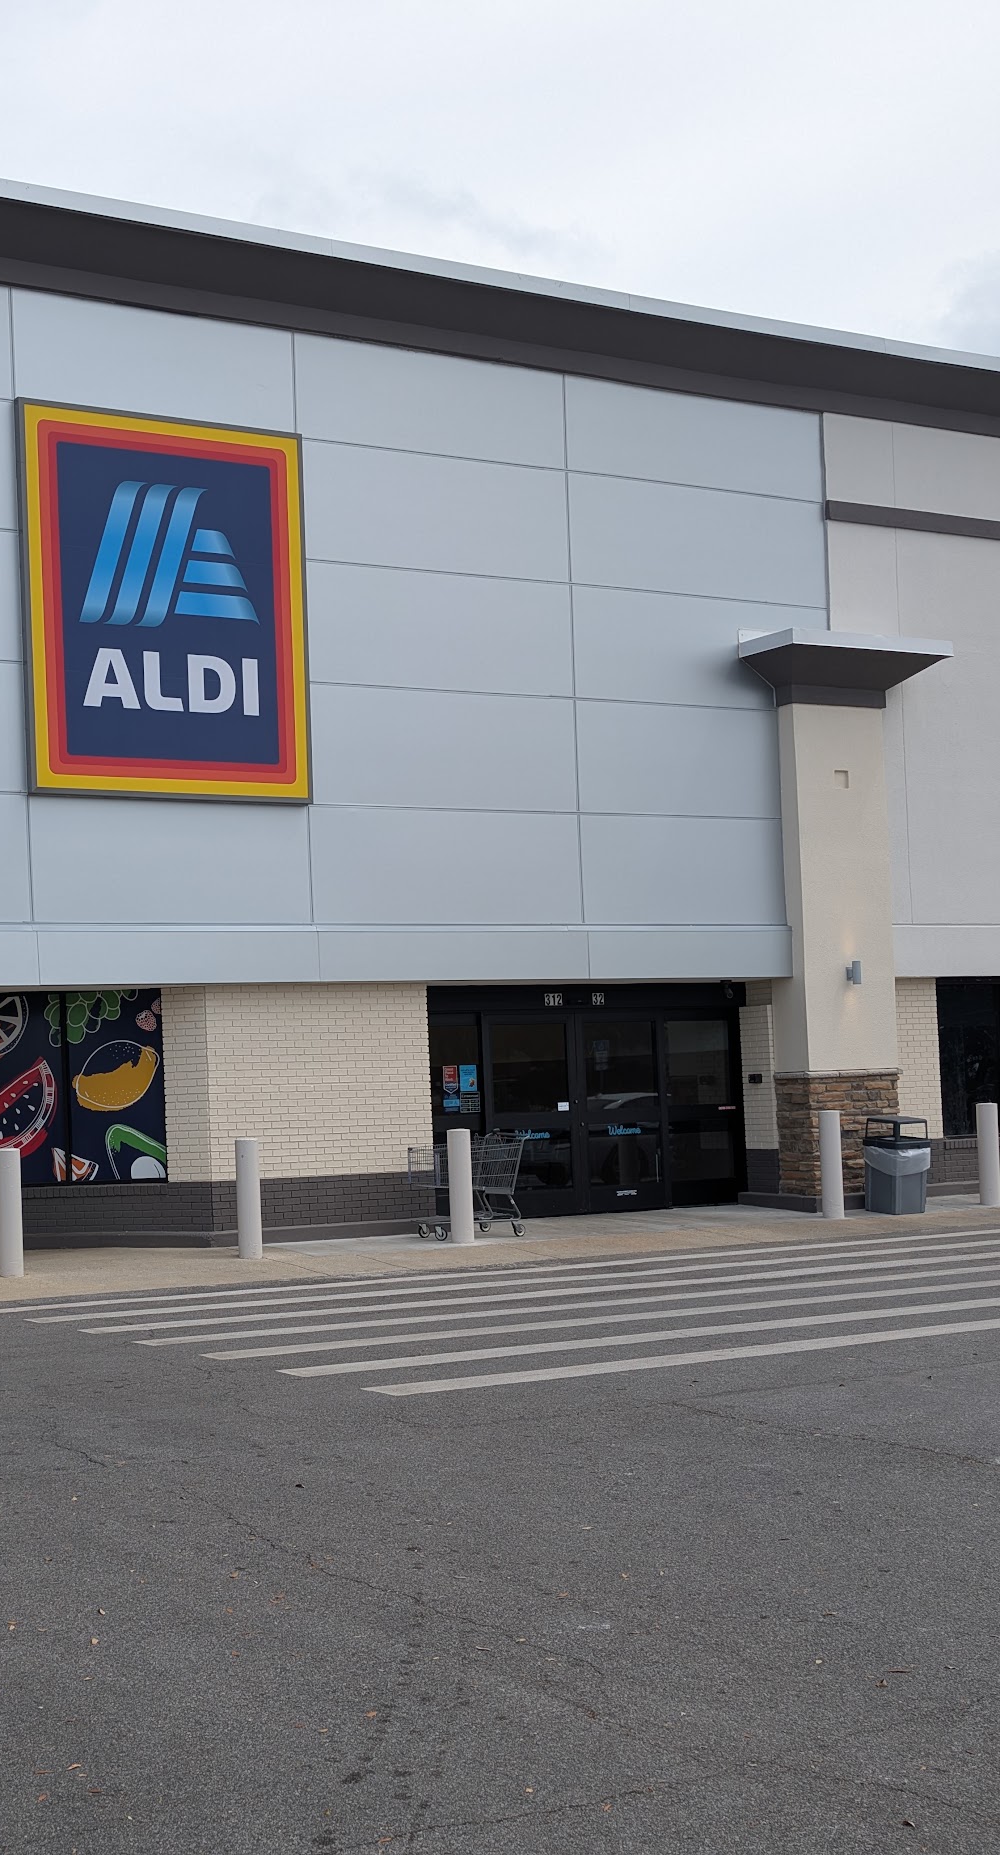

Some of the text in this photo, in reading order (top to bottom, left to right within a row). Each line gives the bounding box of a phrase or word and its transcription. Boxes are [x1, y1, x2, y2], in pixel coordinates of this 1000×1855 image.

[83, 647, 260, 716] ALDI
[545, 993, 604, 1006] 312 32
[607, 1125, 642, 1136] Welcome
